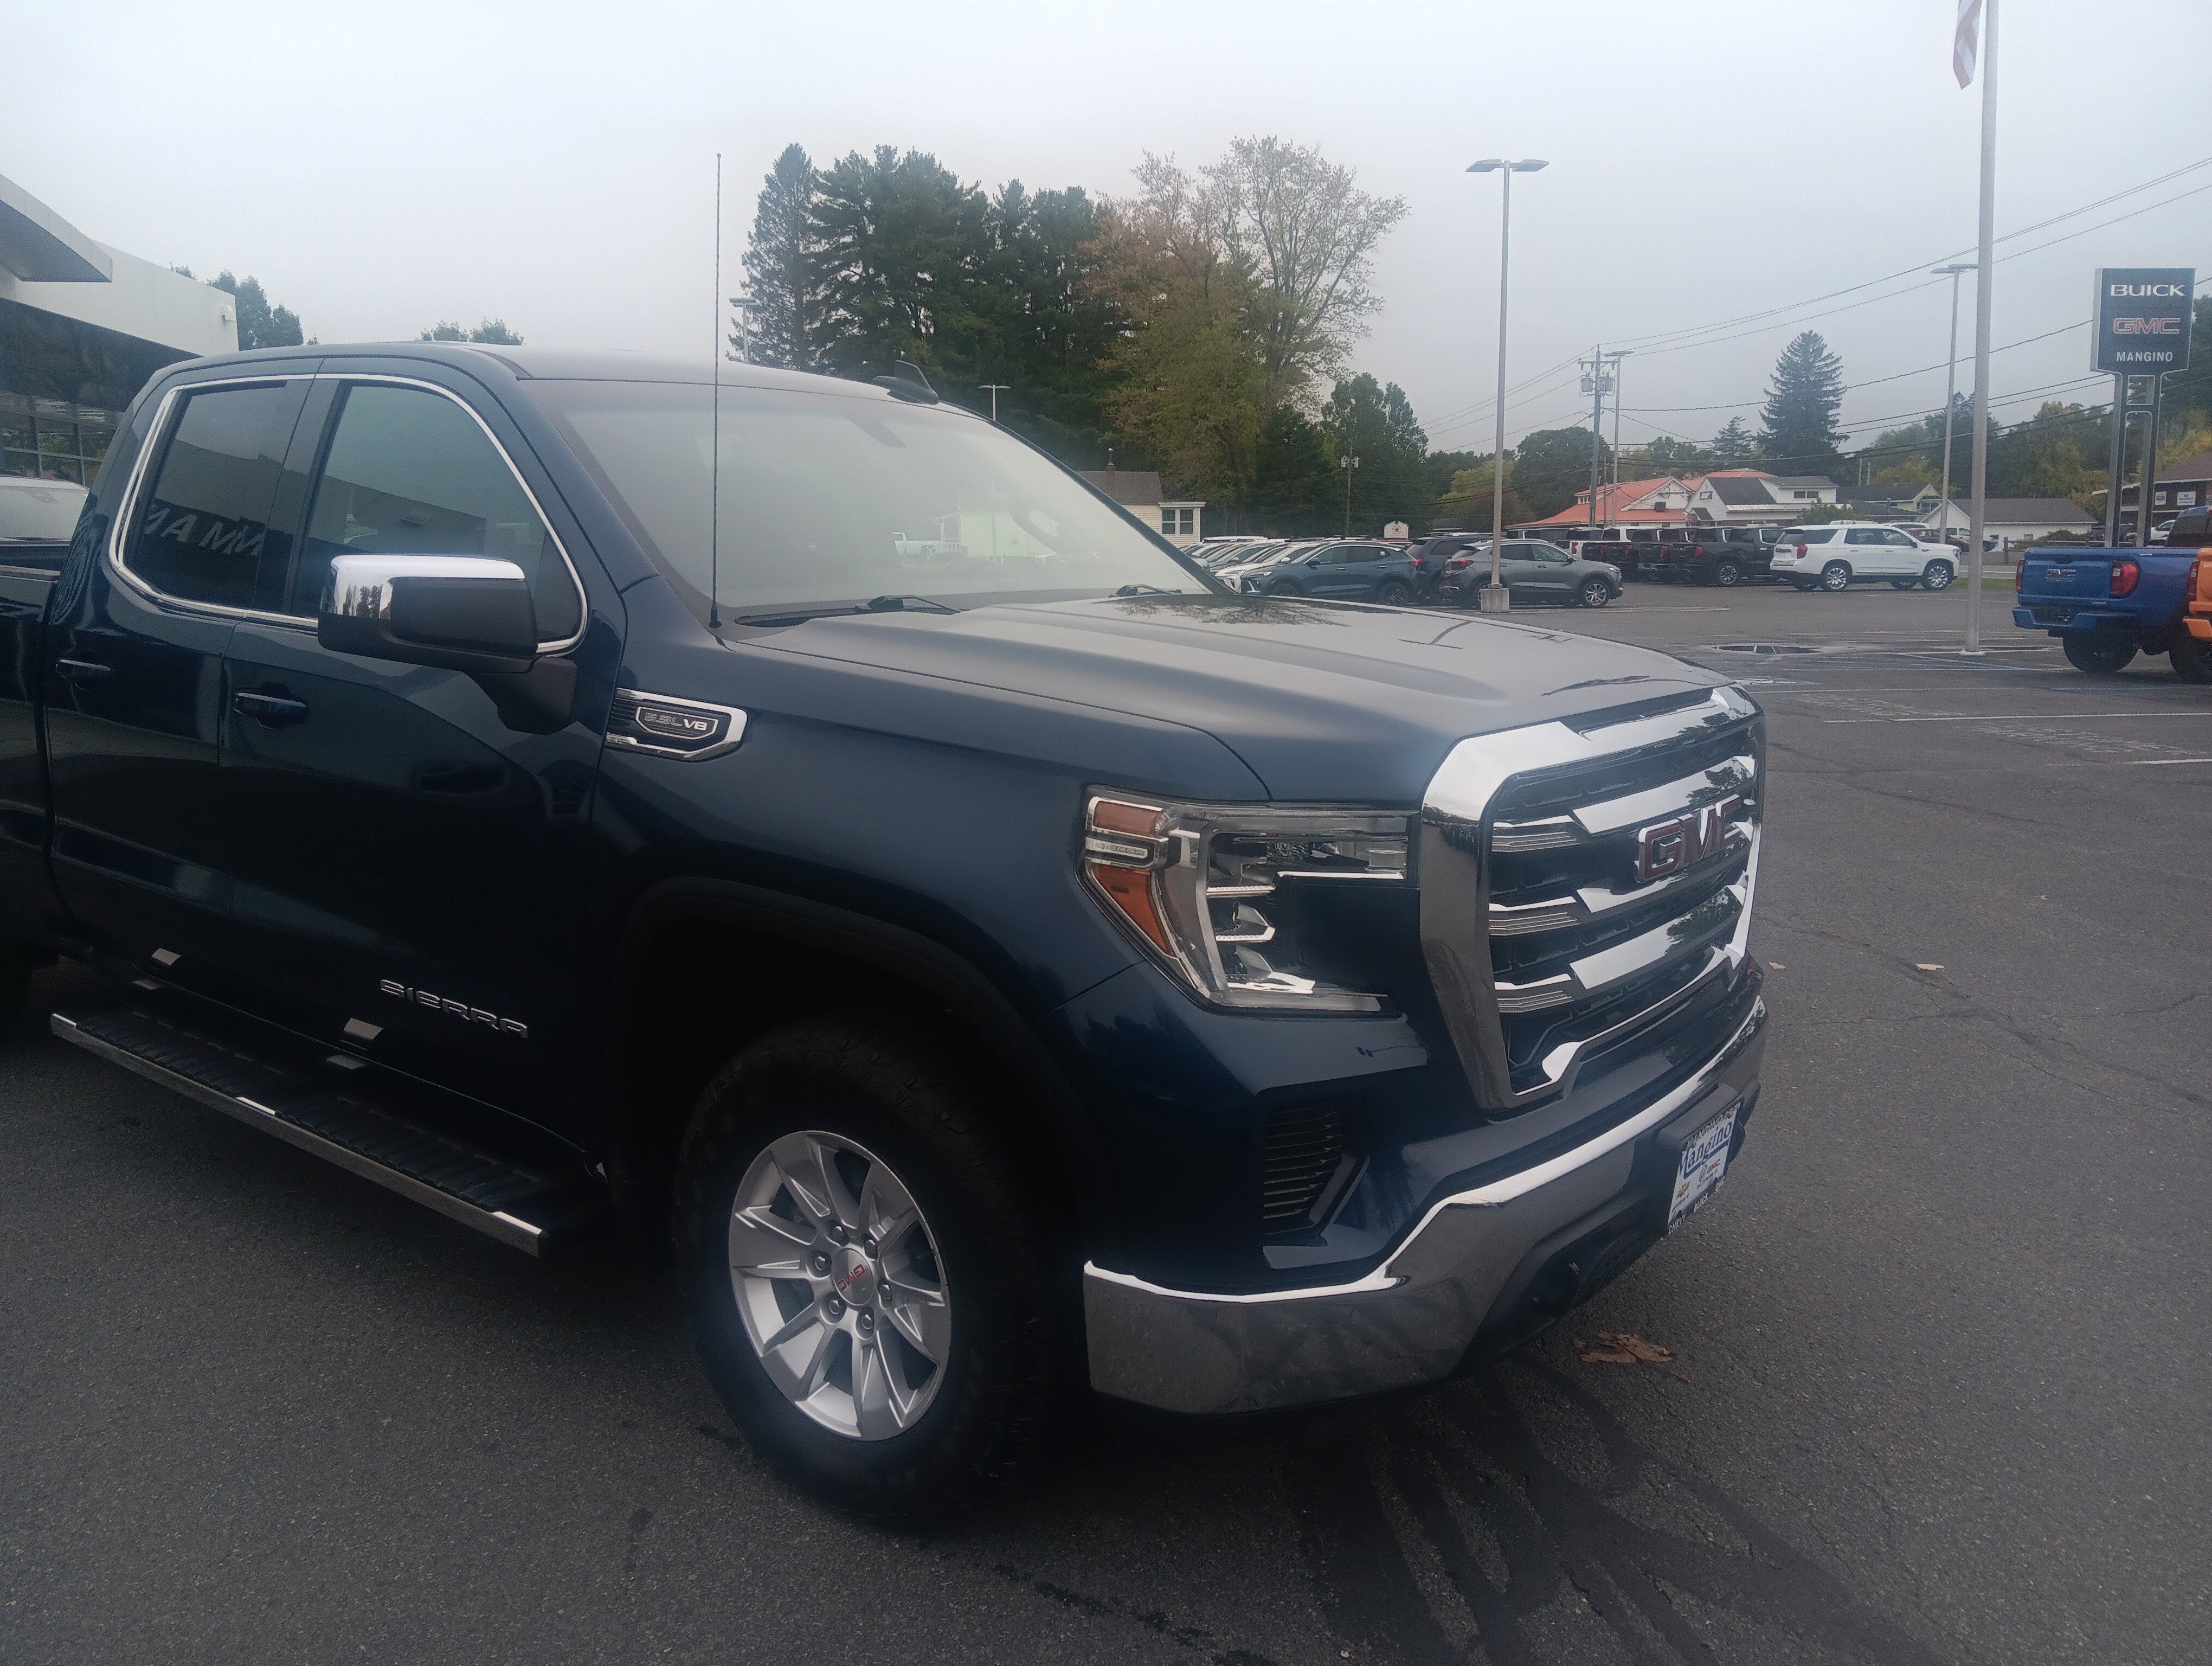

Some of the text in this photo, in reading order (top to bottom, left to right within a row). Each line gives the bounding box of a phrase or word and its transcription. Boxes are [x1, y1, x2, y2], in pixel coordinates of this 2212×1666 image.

[2111, 284, 2185, 297] BUICK
[2113, 317, 2181, 335] GMC
[2117, 351, 2174, 362] MANGINO
[645, 712, 708, 731] 5.3L V8
[1635, 793, 1744, 883] GMC
[380, 979, 528, 1039] SIERRA
[838, 1264, 866, 1292] GMC
